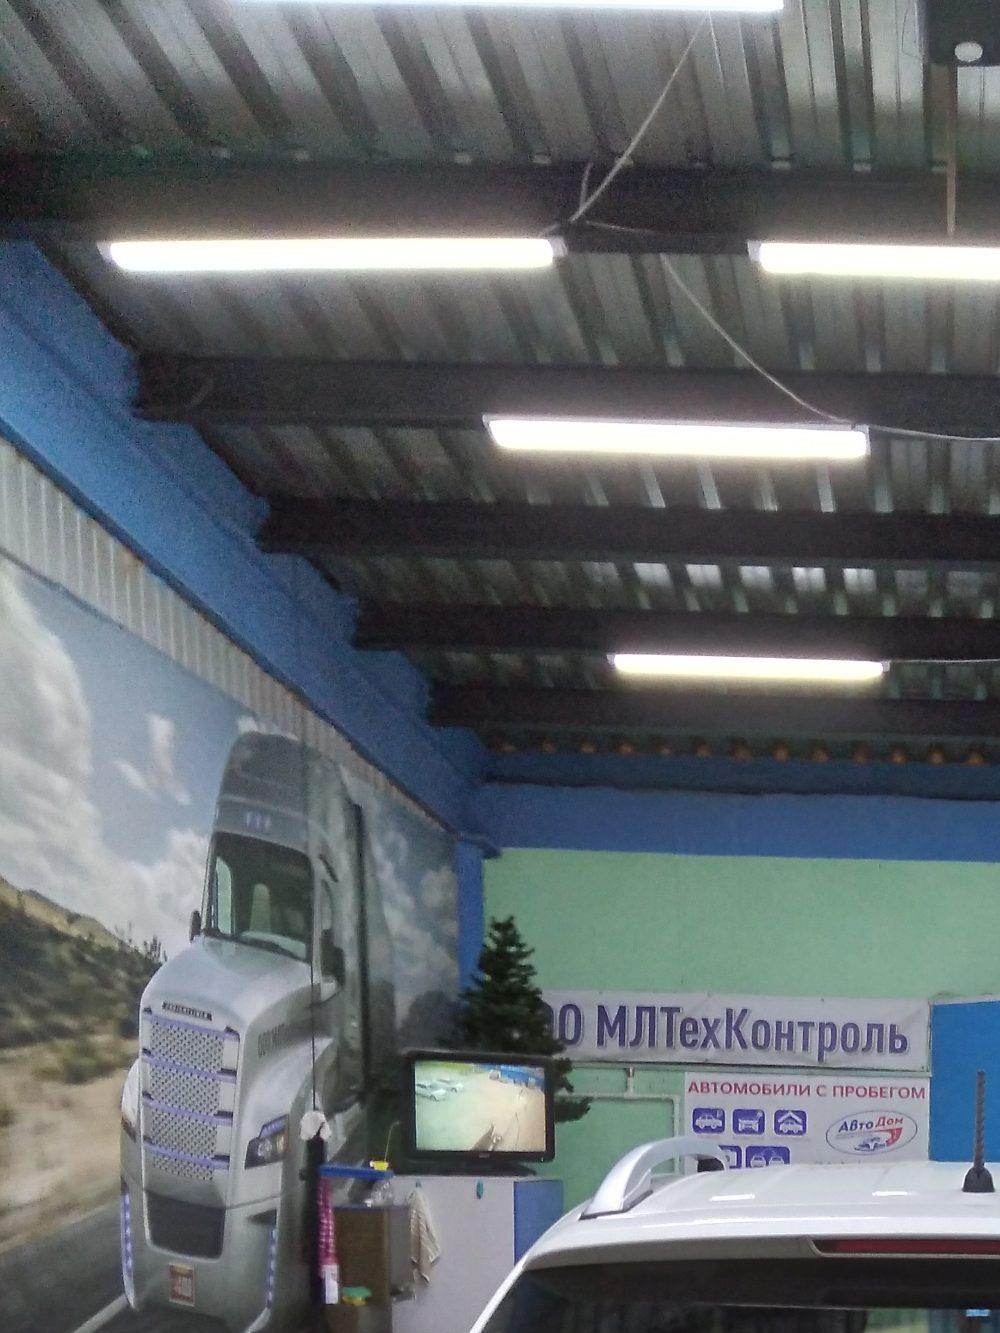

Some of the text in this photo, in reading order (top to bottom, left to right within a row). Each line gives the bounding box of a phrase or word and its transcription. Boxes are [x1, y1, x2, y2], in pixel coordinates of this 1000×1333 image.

[597, 1004, 908, 1063] МЛТехКонтроль
[688, 1082, 925, 1100] АВТОМОБИЛИ С ПРОБЕГОМ
